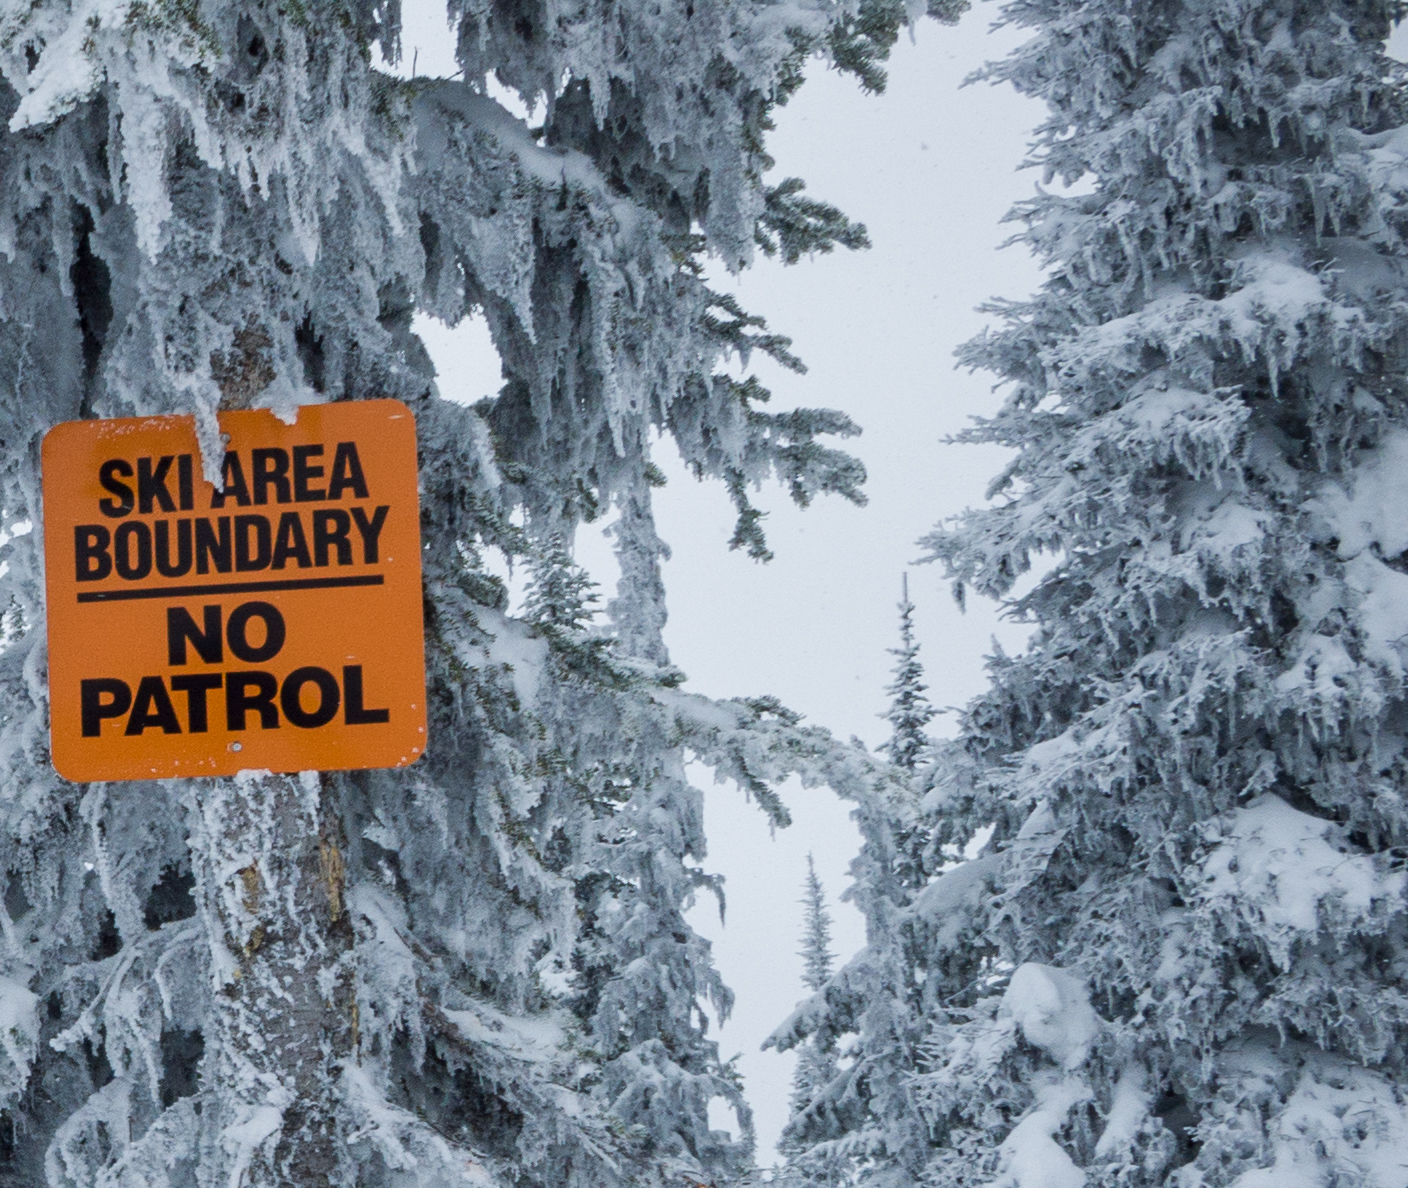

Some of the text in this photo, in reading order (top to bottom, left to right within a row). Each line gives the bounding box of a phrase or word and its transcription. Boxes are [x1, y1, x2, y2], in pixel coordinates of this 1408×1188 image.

[98, 441, 370, 519] SKI AREA
[74, 505, 390, 582] BOUNDARY
[166, 601, 286, 667] NO
[80, 665, 390, 738] PATROL
